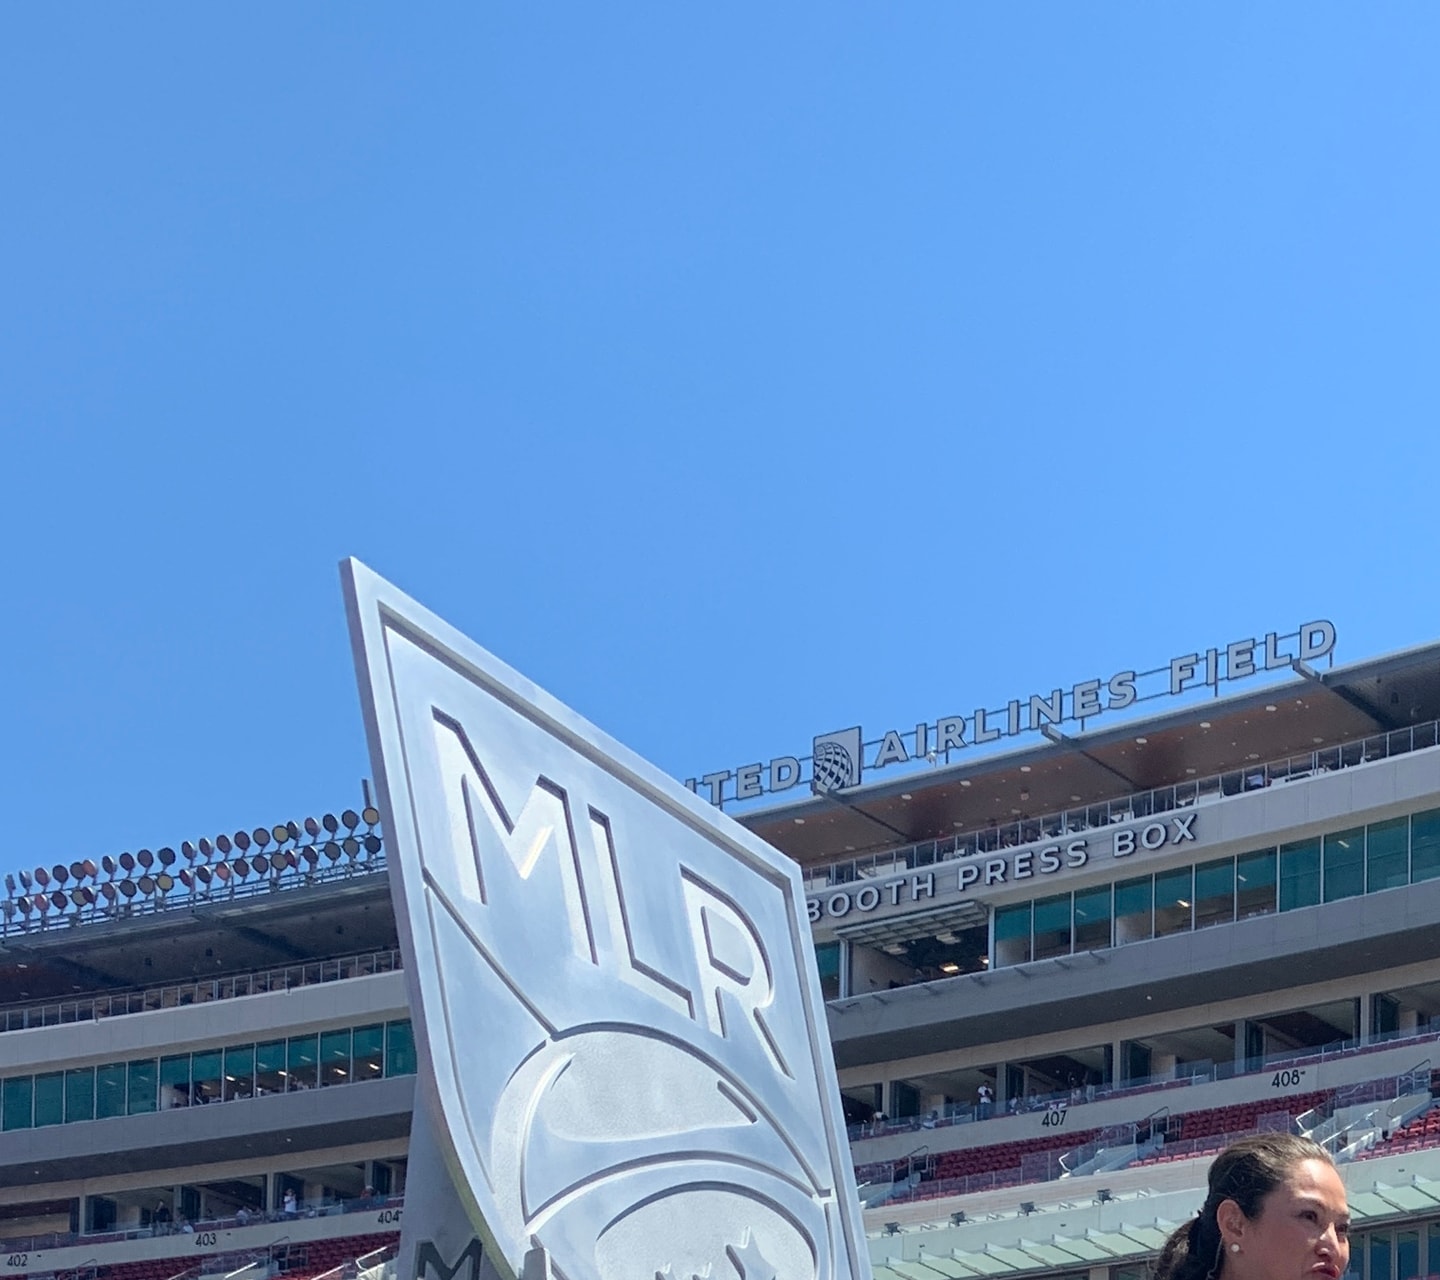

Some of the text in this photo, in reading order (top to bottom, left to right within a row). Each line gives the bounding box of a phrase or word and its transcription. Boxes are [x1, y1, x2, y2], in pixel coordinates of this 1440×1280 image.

[684, 619, 1337, 806] TED AIRLINES FIELD
[957, 840, 1088, 892] PRESS
[1112, 813, 1198, 858] BOX
[430, 704, 797, 1081] MLR
[1271, 1069, 1300, 1088] 408
[1041, 1110, 1067, 1128] 407
[376, 1209, 400, 1225] 404
[195, 1232, 217, 1247] 403
[6, 1253, 28, 1268] 402
